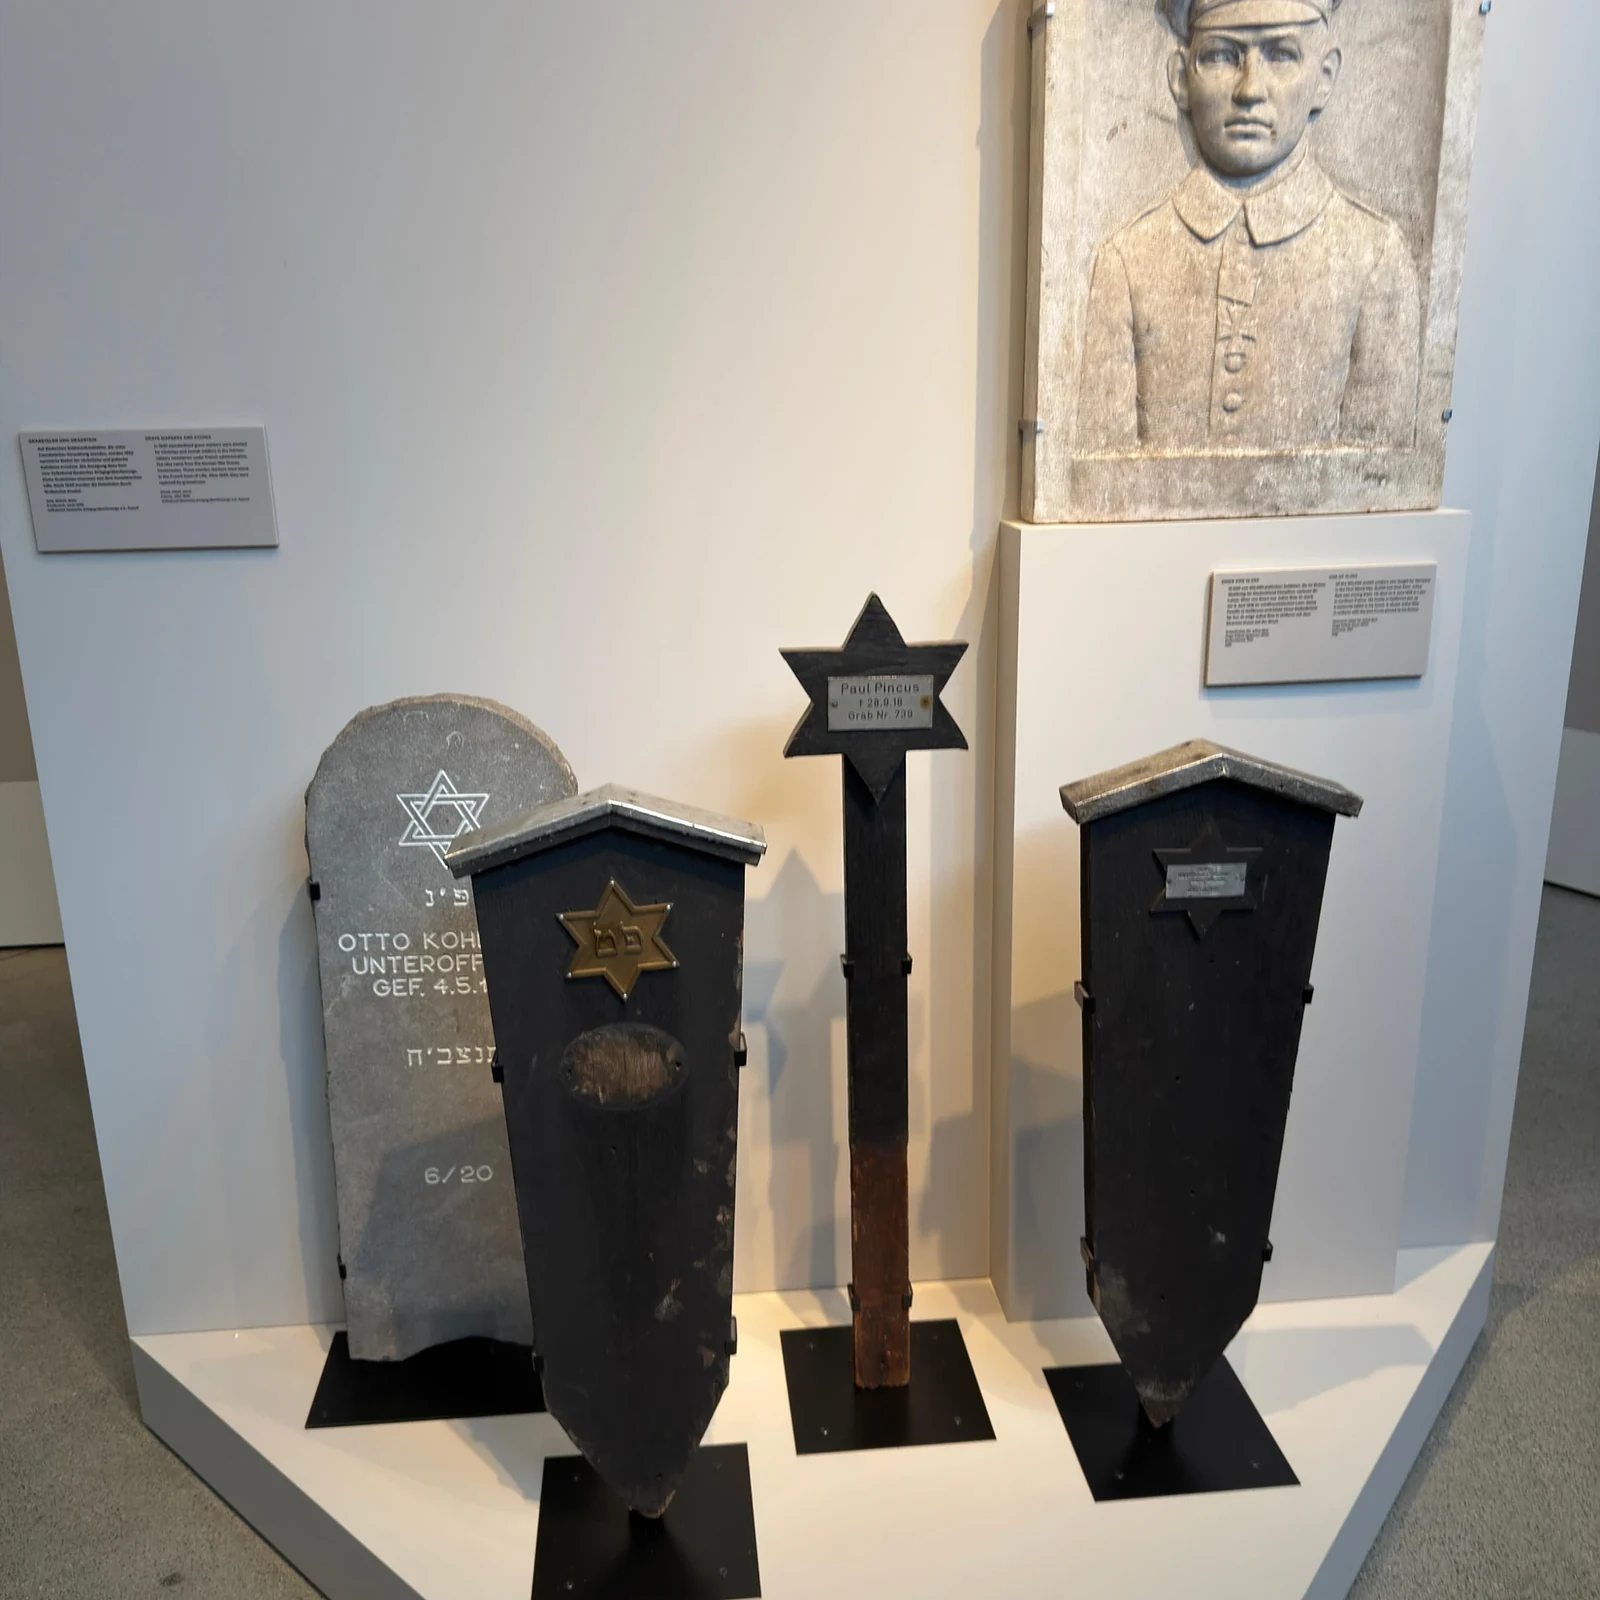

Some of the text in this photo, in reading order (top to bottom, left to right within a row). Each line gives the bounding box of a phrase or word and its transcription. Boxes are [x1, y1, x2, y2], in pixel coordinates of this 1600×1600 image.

[841, 681, 920, 695] Paul Pincus
[848, 710, 873, 720] Grab
[338, 932, 411, 952] OTTO
[372, 978, 425, 997] GEF.
[424, 1164, 494, 1185] 6/20
